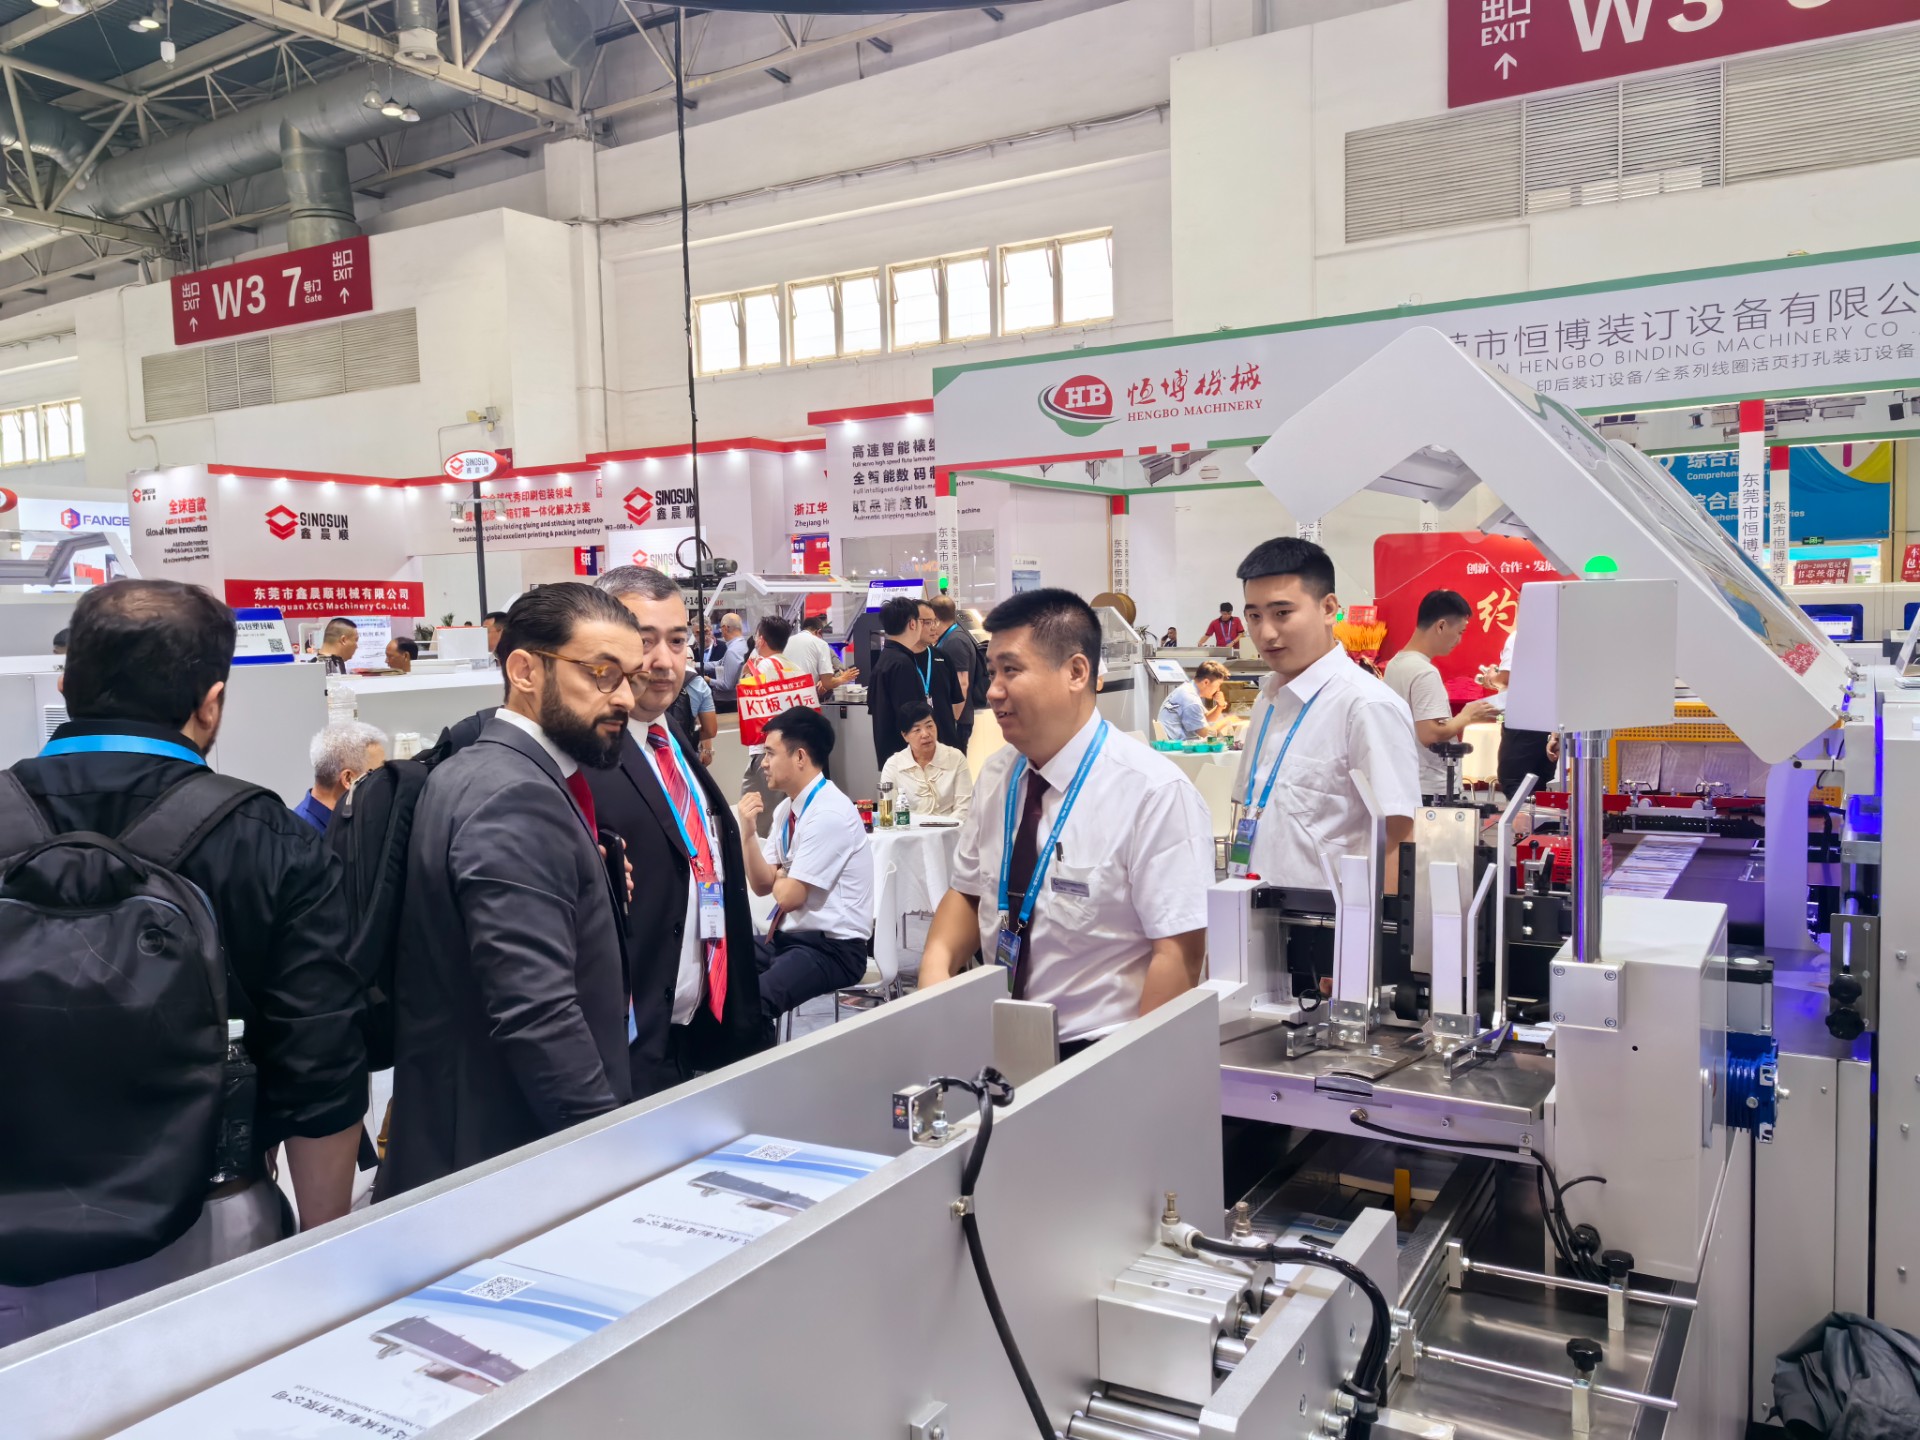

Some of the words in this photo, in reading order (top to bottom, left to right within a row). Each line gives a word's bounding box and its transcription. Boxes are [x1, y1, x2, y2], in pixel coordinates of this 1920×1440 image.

[1481, 19, 1531, 47] EXIT
[332, 249, 353, 267] 出口
[333, 267, 354, 282] EXIT
[182, 282, 200, 298] 出口
[212, 275, 266, 320] W3
[282, 266, 302, 307] 7
[303, 279, 322, 293] 号门
[183, 298, 200, 311] EXIT
[304, 294, 323, 304] Gate
[1520, 353, 1604, 374] HENGBO
[1615, 341, 1706, 364] BINDING
[1718, 326, 1853, 353] MACHINERY
[1065, 384, 1106, 409] HB
[1127, 407, 1179, 422] HENGBO
[1184, 398, 1263, 416] MACHINERY
[466, 457, 489, 466] SINOSUN
[655, 487, 695, 506] SINOSUN
[300, 512, 349, 529] SINOSUN
[551, 519, 576, 528] stitching
[795, 519, 821, 529] Zhejiang
[300, 528, 349, 541] 鑫晨顺
[577, 528, 601, 537] industry
[254, 587, 409, 601] 东莞市鑫晨顺机械有限公司
[326, 602, 374, 612] Machinery
[376, 602, 410, 611] Co.,Ltd.
[746, 695, 784, 716] KT板
